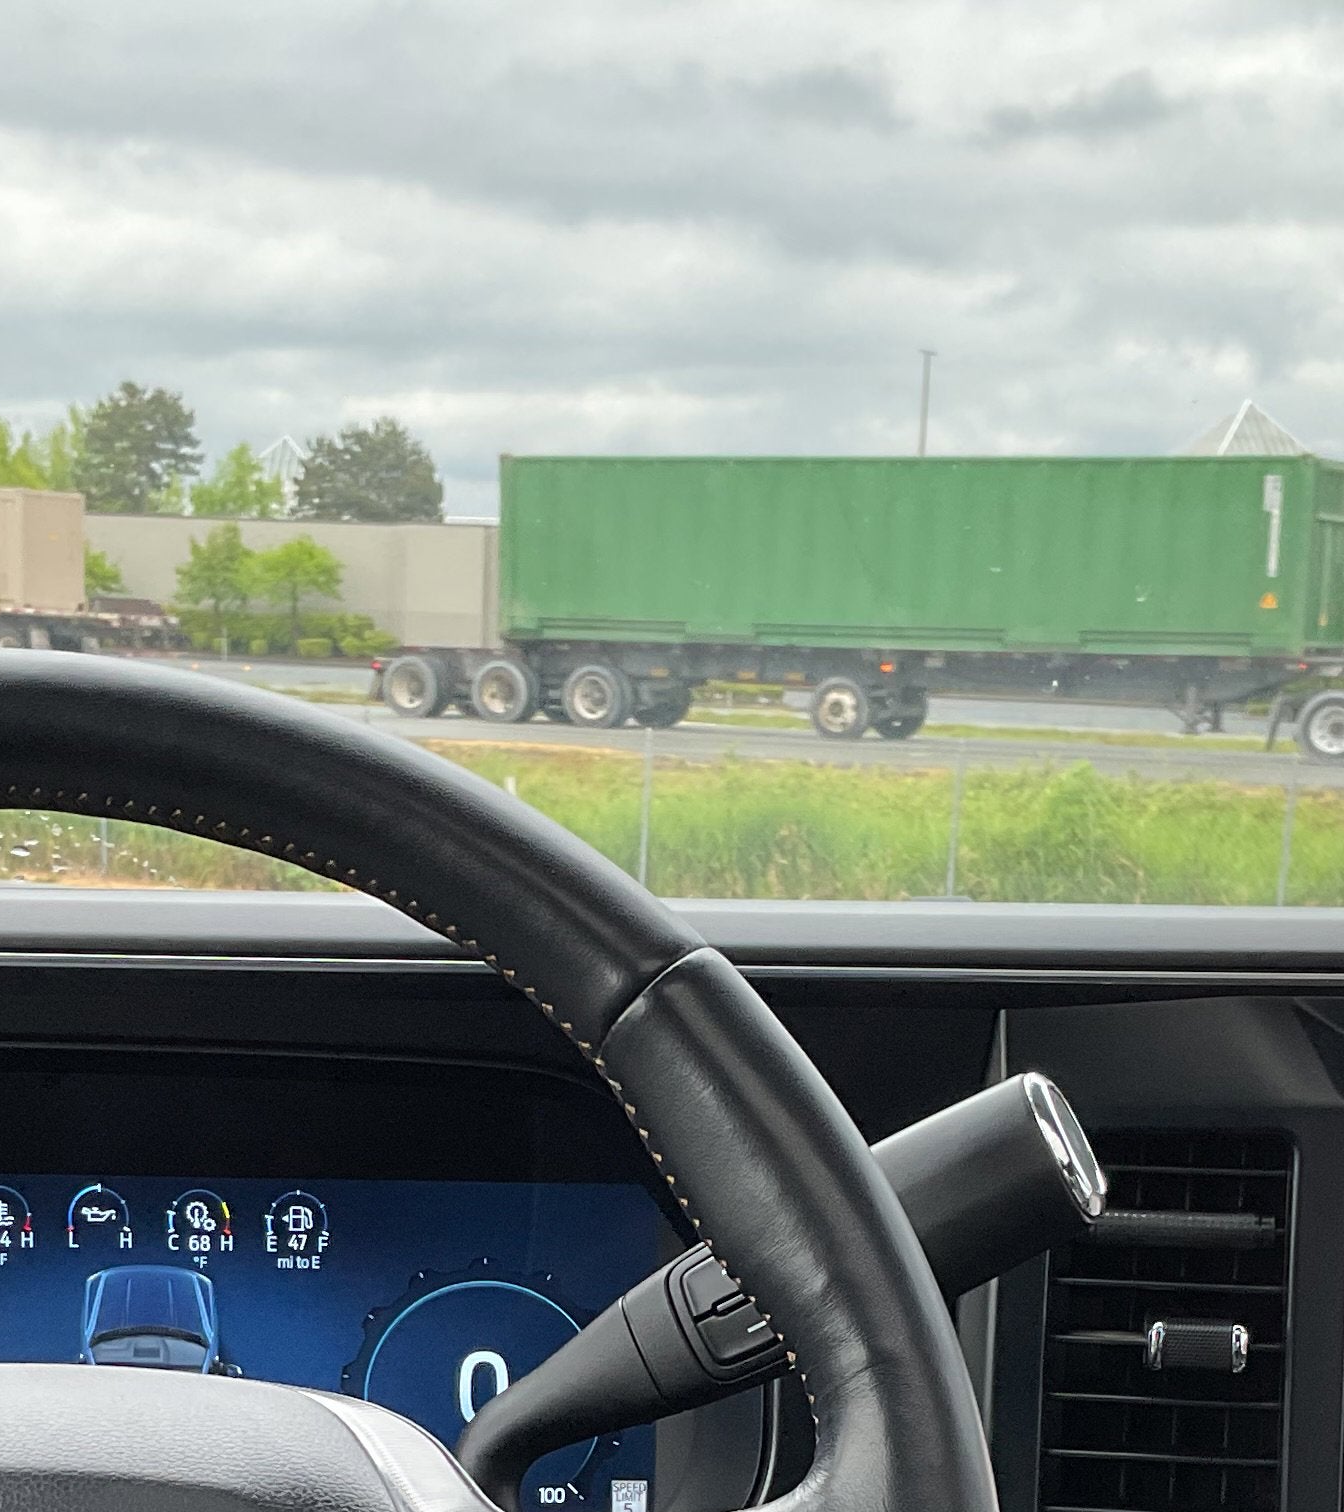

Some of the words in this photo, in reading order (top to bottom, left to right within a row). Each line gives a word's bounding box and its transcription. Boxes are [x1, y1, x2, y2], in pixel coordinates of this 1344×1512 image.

[20, 1231, 34, 1248] H
[68, 1231, 80, 1248] L
[119, 1231, 133, 1249] H
[188, 1234, 211, 1251] 68
[220, 1234, 234, 1252] H
[287, 1234, 308, 1251] 47
[538, 1487, 566, 1504] 100
[613, 1482, 647, 1492] SPEED
